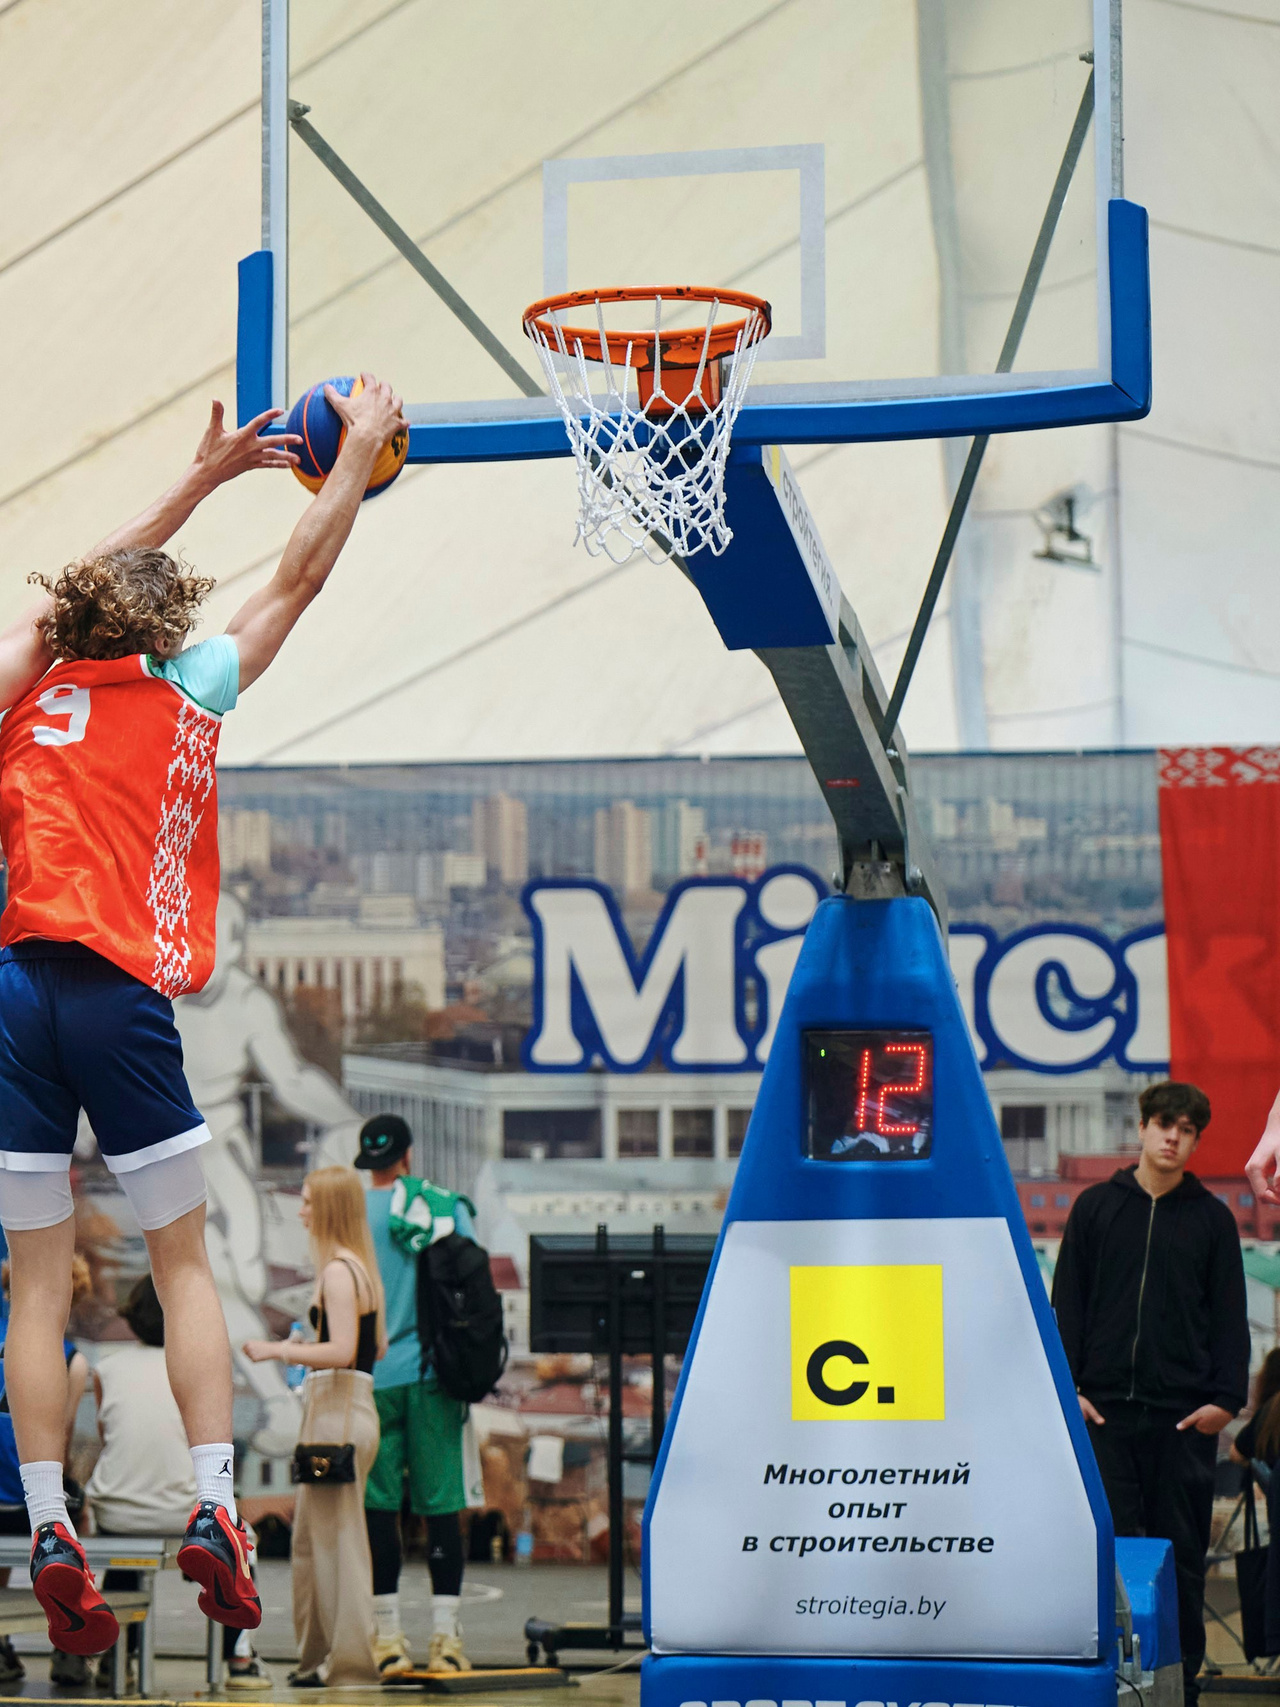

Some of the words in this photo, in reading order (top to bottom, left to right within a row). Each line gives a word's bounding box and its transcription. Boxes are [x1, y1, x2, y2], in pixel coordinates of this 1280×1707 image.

[32, 683, 91, 746] 9
[857, 1043, 926, 1133] 12
[763, 1462, 971, 1485] Многолетний
[828, 1502, 907, 1518] опыт
[742, 1536, 758, 1551] в
[769, 1535, 995, 1557] строительстве
[795, 1596, 947, 1619] stroitegia.by
